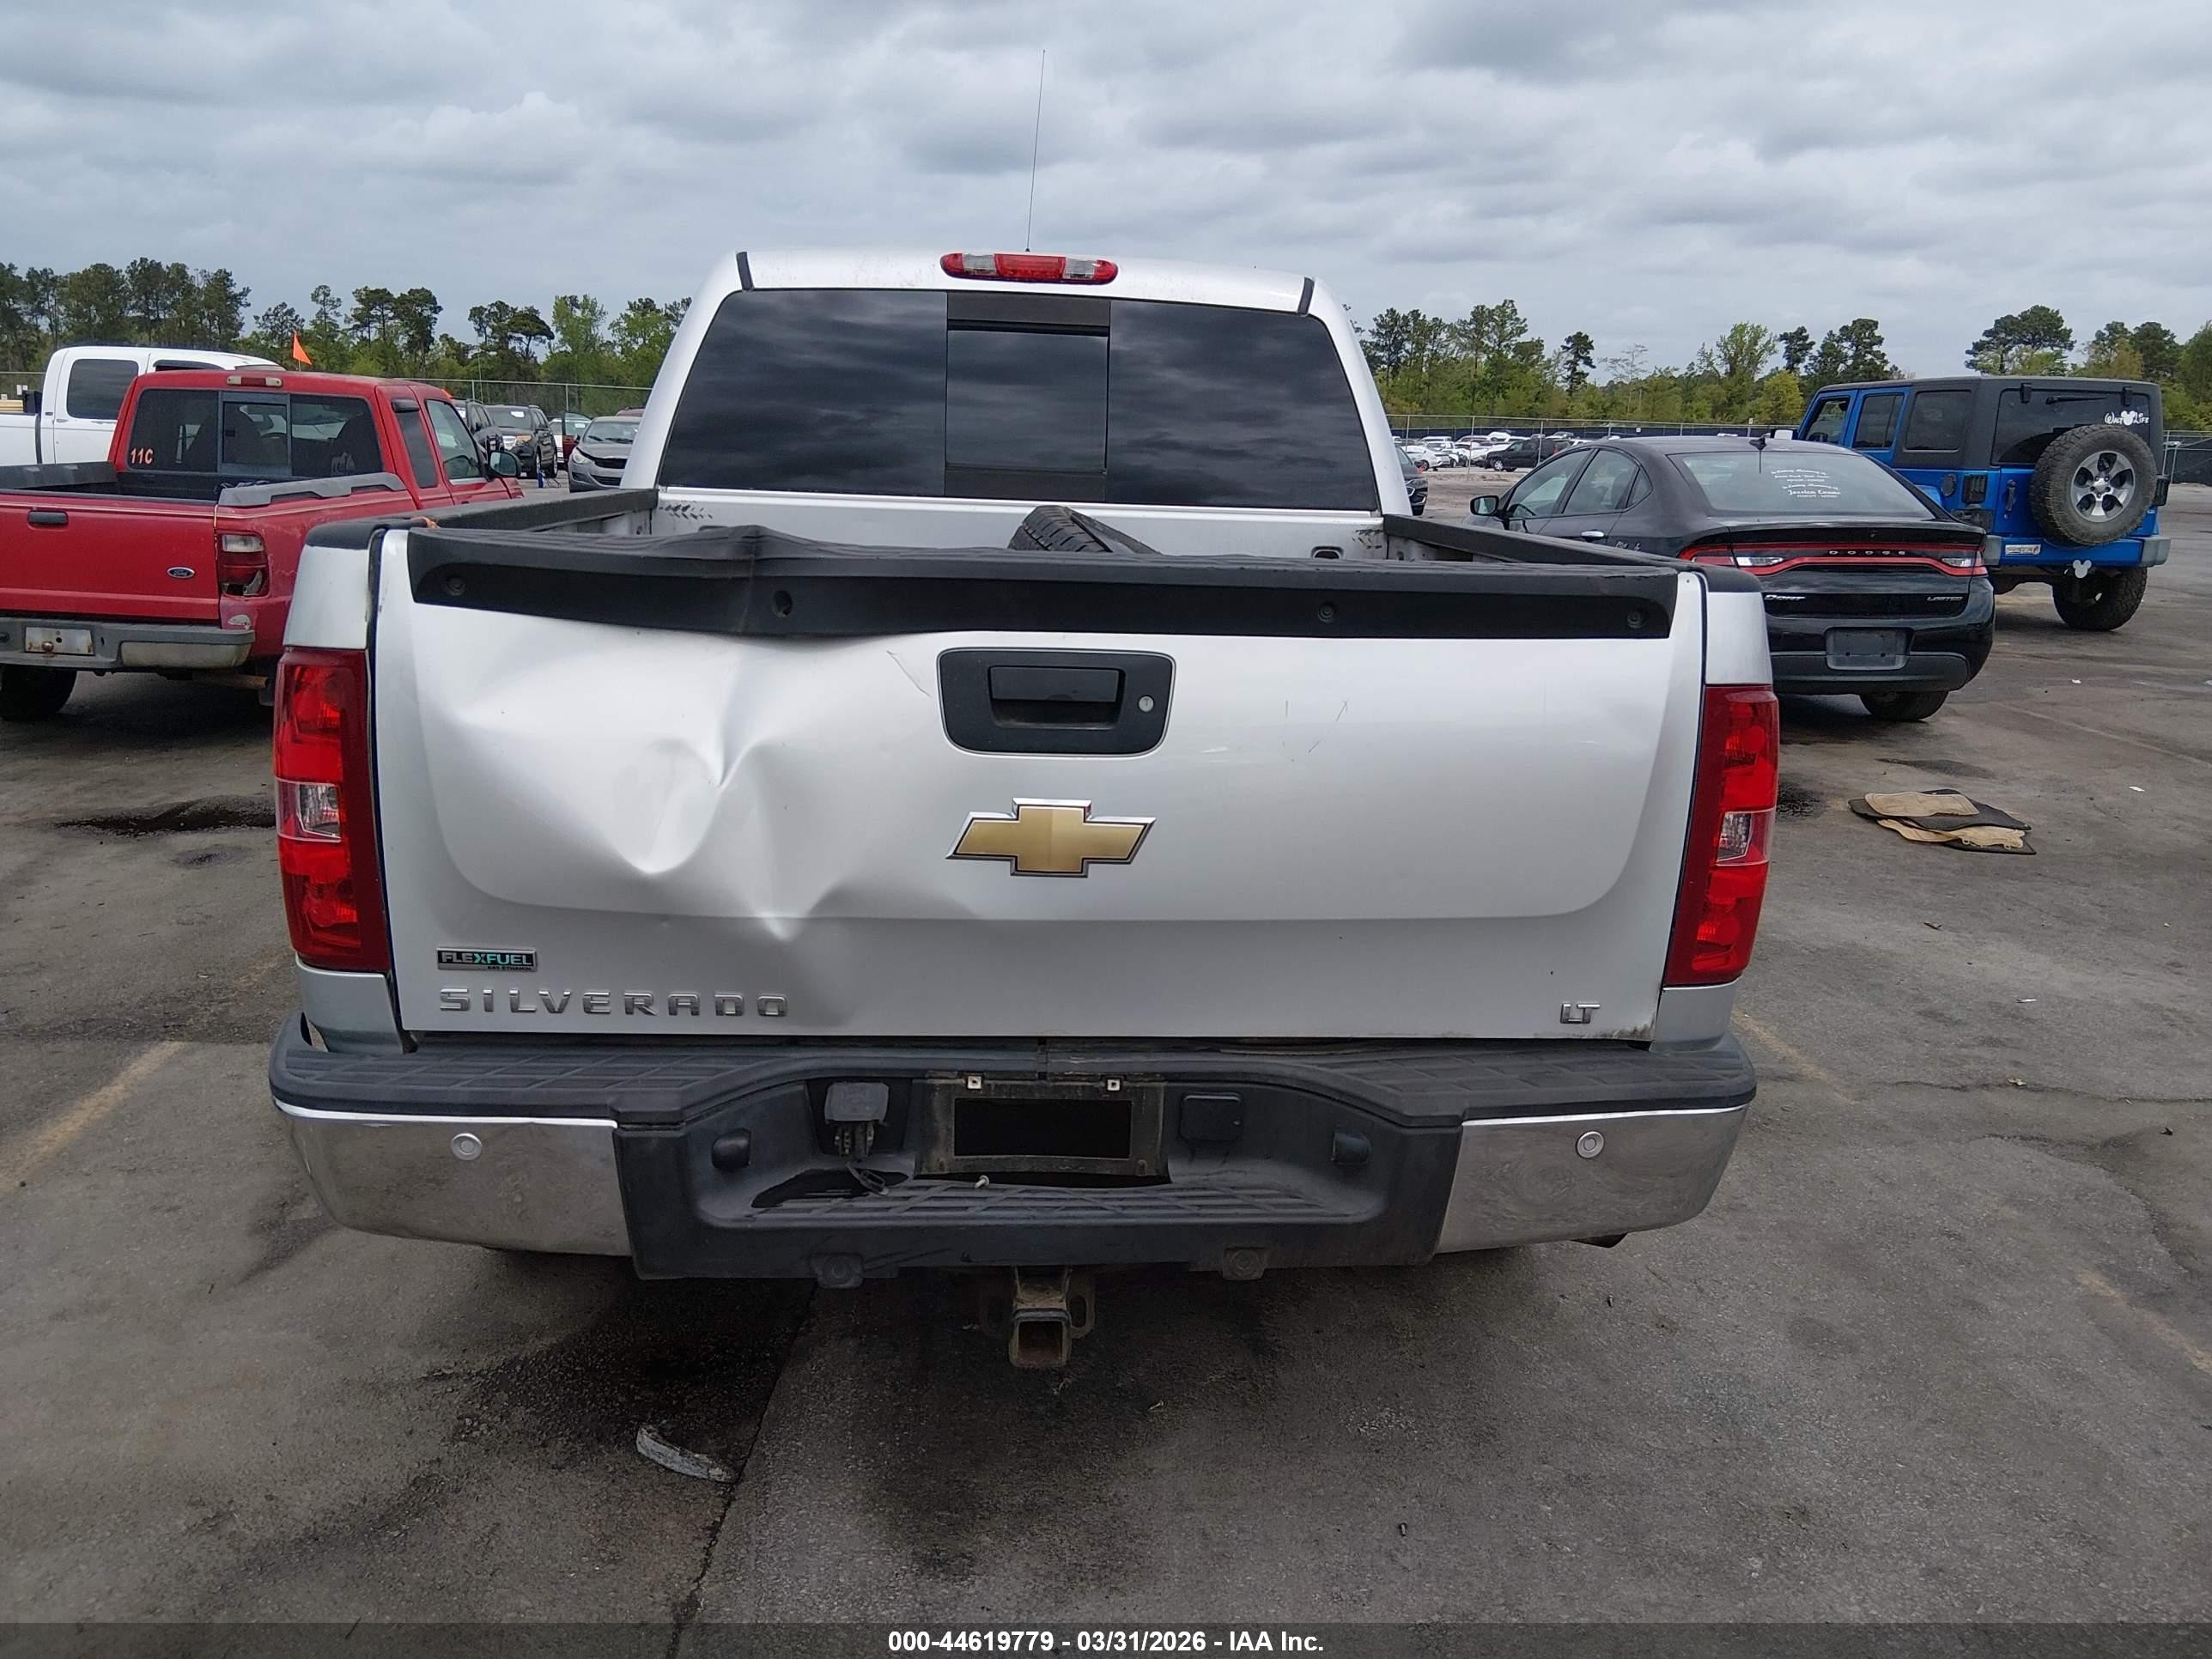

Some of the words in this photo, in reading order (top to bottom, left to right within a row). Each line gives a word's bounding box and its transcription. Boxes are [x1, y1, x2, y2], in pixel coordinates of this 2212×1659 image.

[131, 448, 154, 464] 11C
[441, 952, 532, 965] FLEXFUEL
[439, 988, 789, 1017] SILVERADO
[1560, 1003, 1601, 1024] LT
